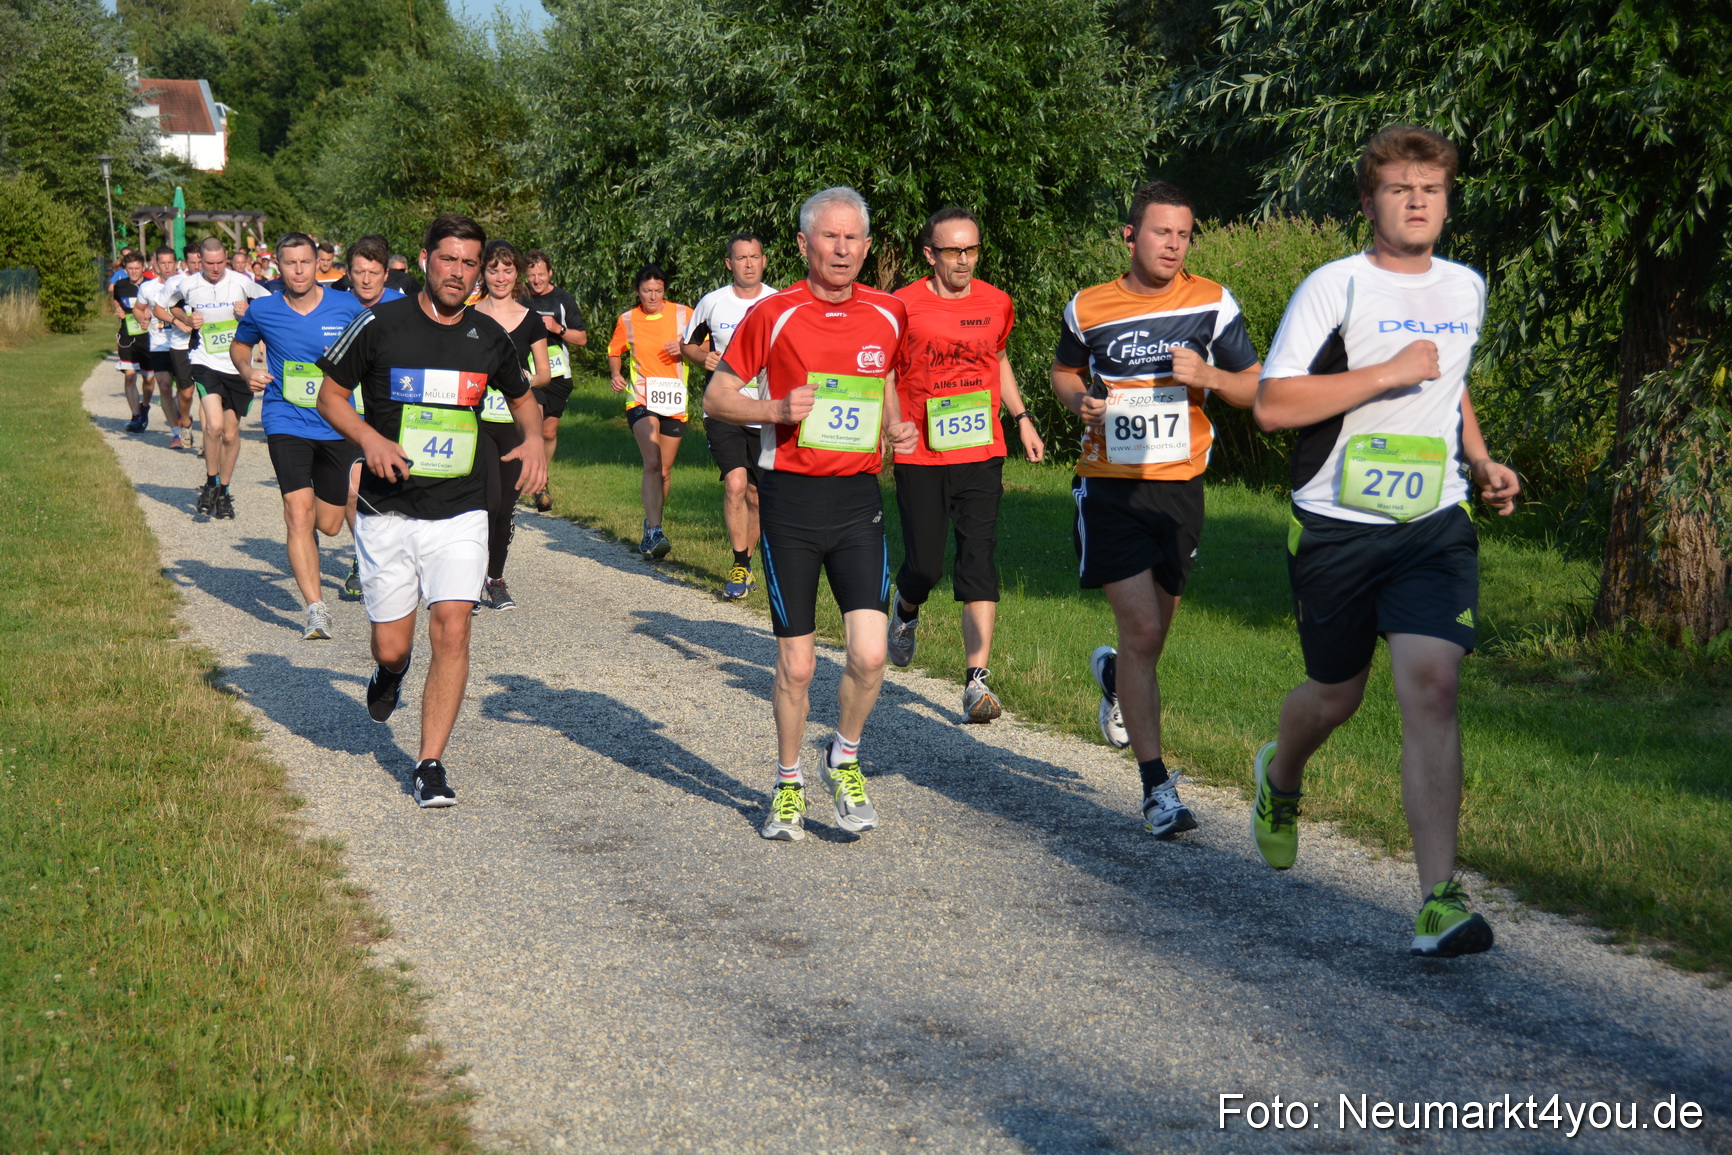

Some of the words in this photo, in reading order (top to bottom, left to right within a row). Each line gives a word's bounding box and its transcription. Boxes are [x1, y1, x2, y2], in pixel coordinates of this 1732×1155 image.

[1378, 320, 1468, 335] DELPHI
[305, 381, 316, 395] 8
[933, 380, 957, 391] Alles
[960, 377, 983, 388] läuft
[424, 389, 456, 400] MÜLLER
[651, 390, 682, 405] 8916
[1107, 392, 1175, 407] df-sports
[827, 405, 860, 431] 35
[935, 413, 986, 437] 1535
[1114, 413, 1180, 441] 8917
[422, 436, 454, 459] 44
[1109, 441, 1187, 453] www.df-sports.de
[1361, 468, 1424, 500] 270
